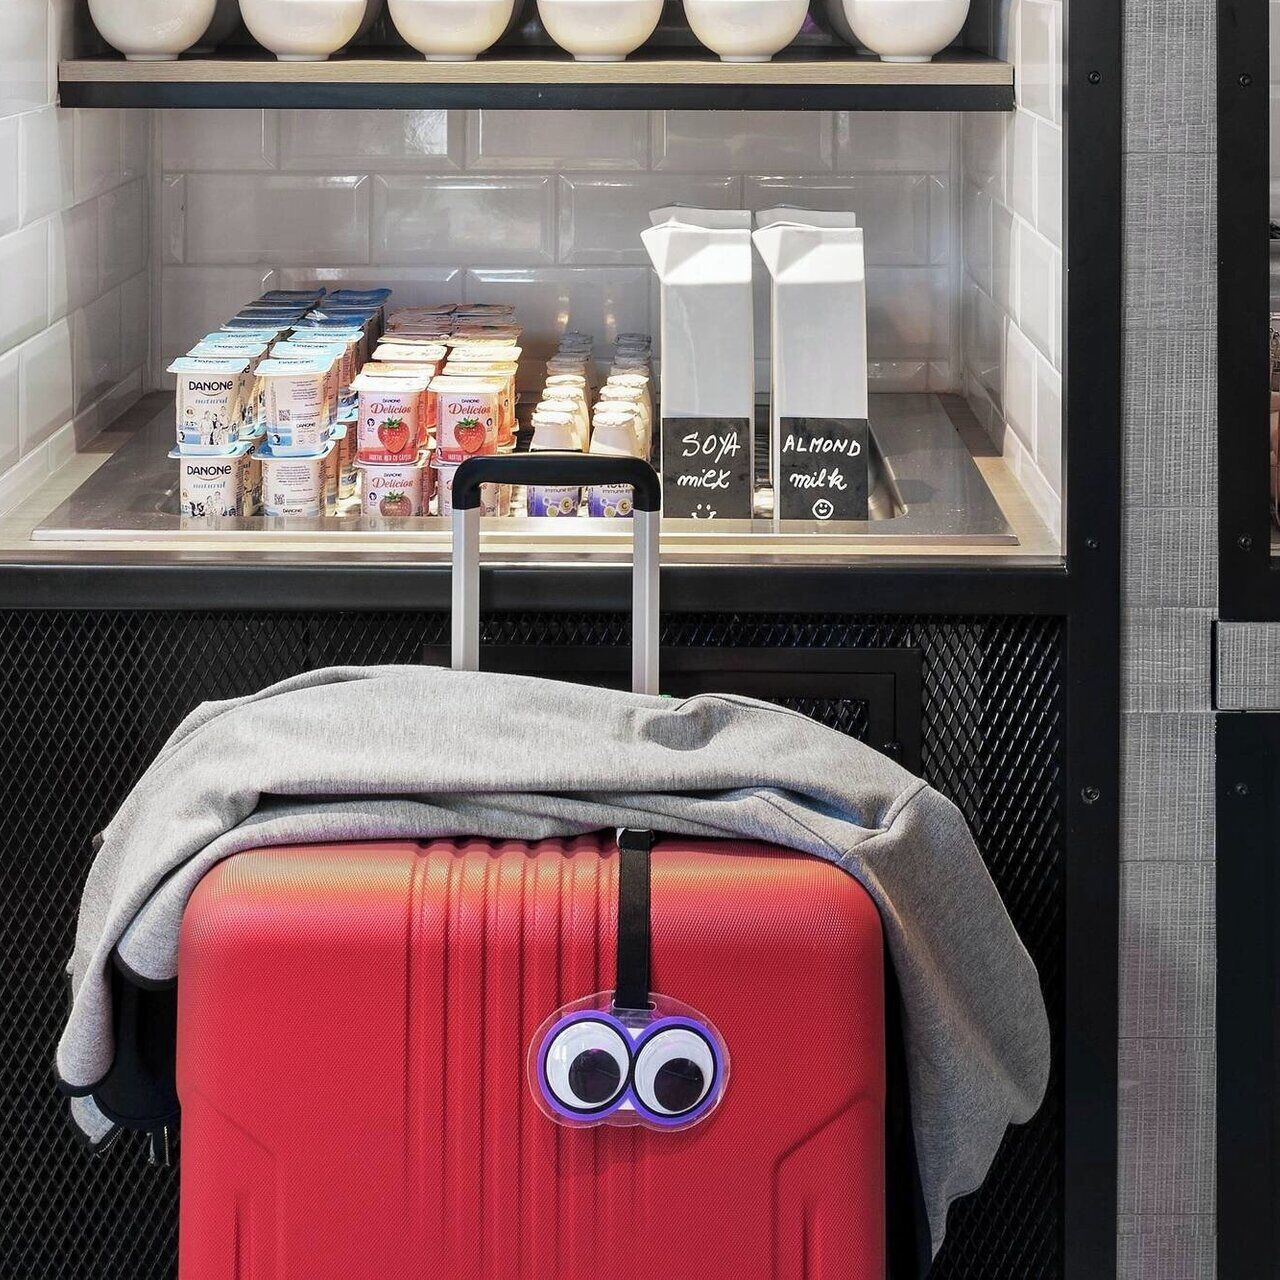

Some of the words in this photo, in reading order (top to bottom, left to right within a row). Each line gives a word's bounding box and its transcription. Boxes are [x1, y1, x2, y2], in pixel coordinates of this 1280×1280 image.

[370, 403, 411, 414] Delicios
[448, 403, 491, 415] Delicios
[682, 432, 741, 464] SOYA
[782, 434, 861, 456] ALMOND
[372, 477, 413, 488] Delicios
[790, 468, 847, 491] milk
